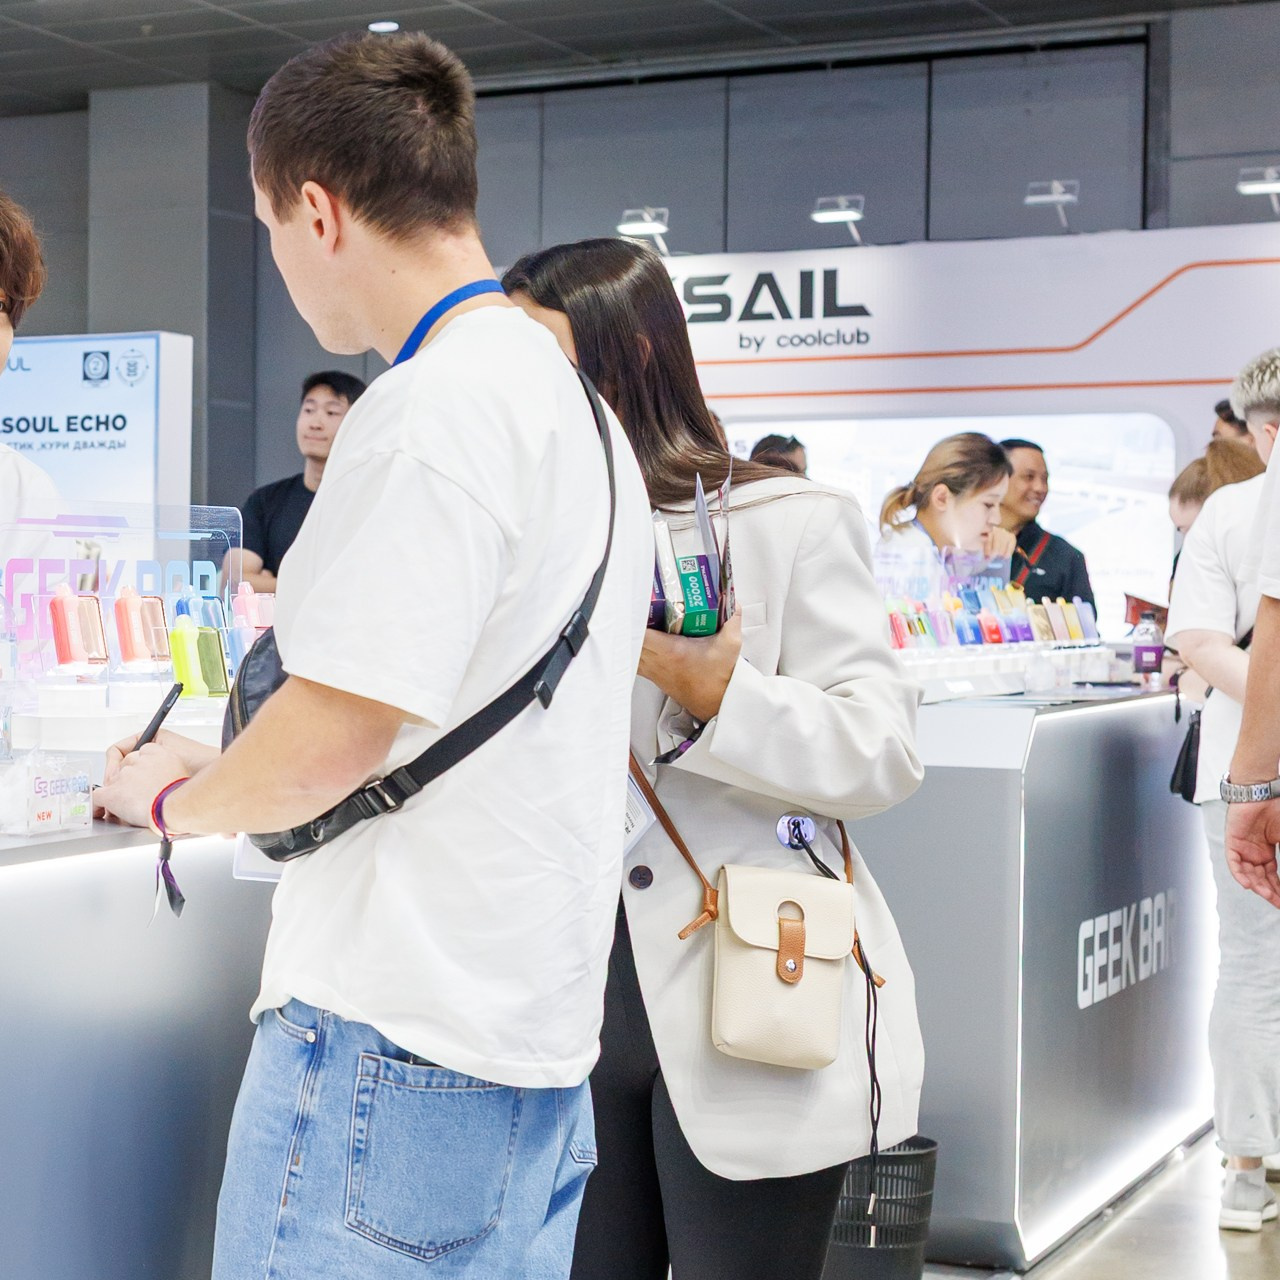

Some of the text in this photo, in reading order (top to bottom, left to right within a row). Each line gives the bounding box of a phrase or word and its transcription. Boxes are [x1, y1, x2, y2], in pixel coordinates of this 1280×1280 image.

[680, 268, 874, 323] SAIL
[739, 328, 870, 353] by coolclub
[66, 414, 128, 432] ECHO
[689, 576, 703, 607] 20000
[36, 809, 53, 822] NEW
[1077, 902, 1137, 1010] GEEK
